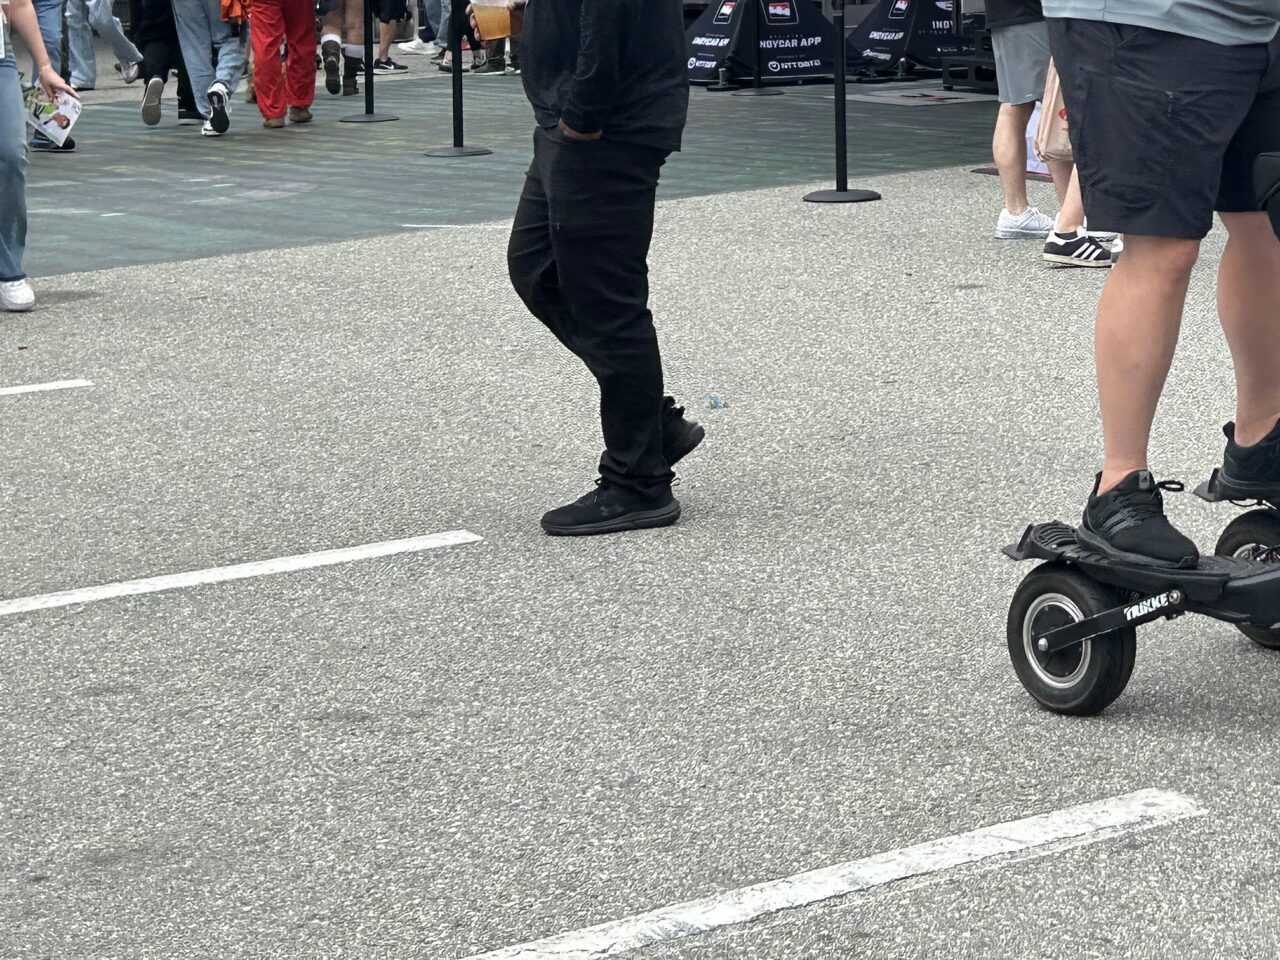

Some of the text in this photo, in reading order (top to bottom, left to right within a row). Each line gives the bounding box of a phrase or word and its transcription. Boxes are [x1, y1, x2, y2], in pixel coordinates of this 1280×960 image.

[760, 38, 798, 49] NDYCAR
[800, 36, 822, 47] APP
[780, 59, 821, 69] NTT DATA
[1123, 592, 1169, 621] TRIKKE
